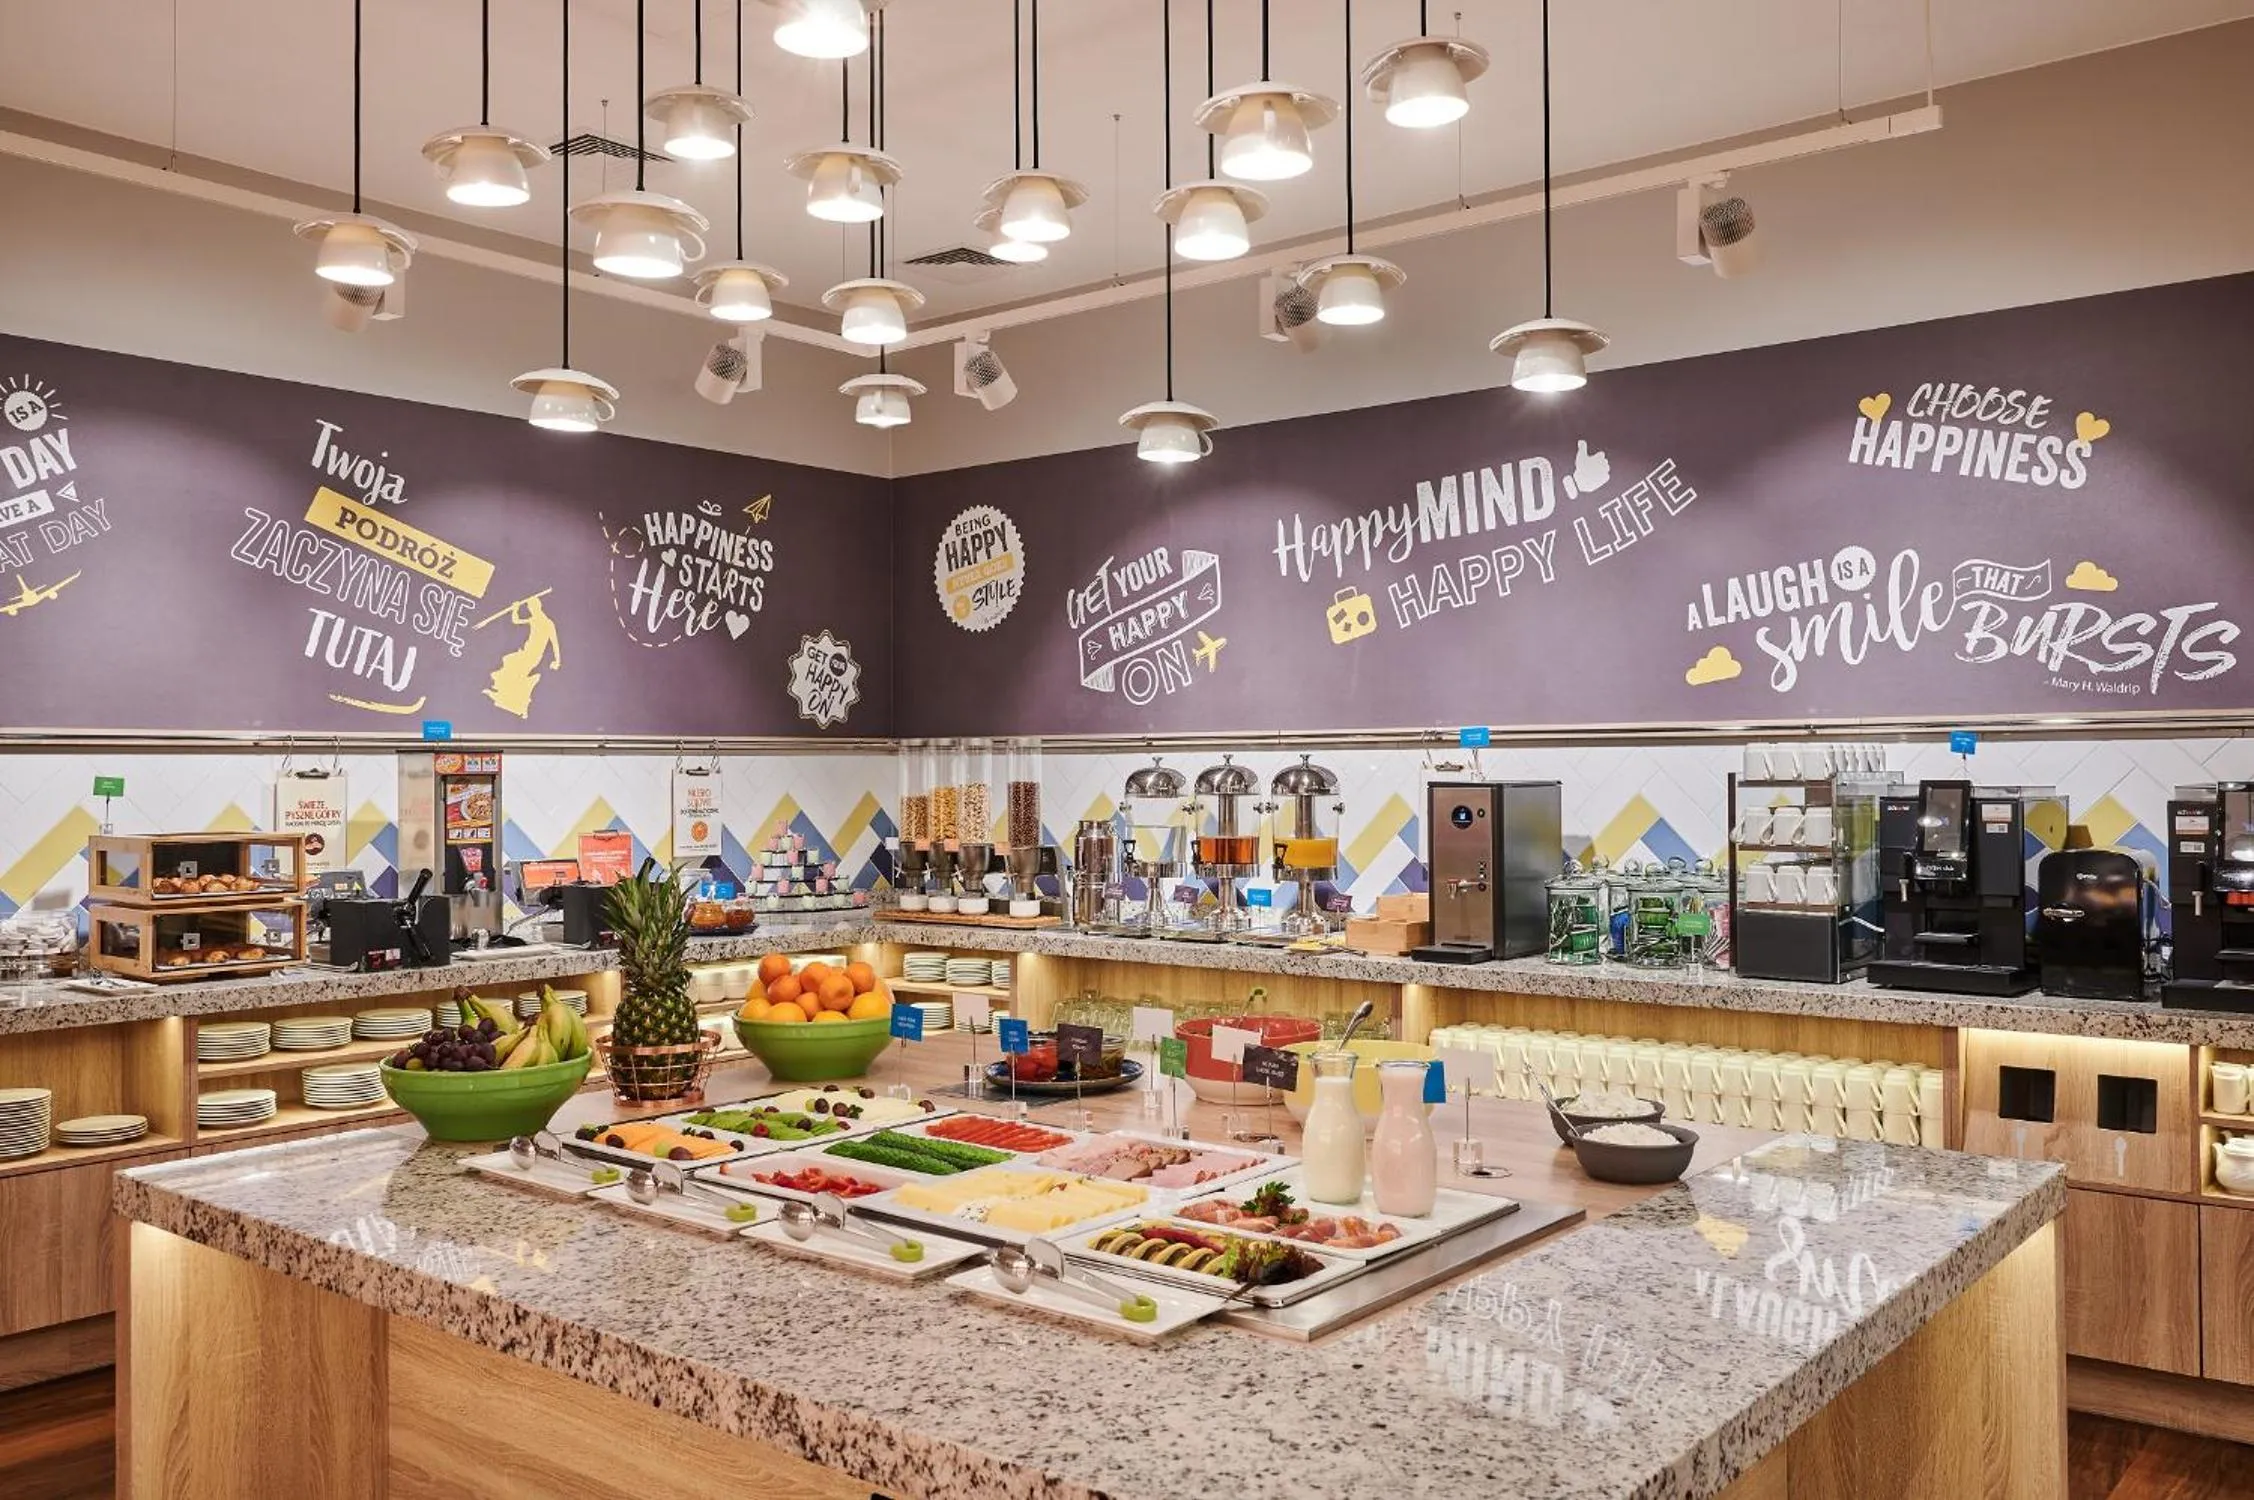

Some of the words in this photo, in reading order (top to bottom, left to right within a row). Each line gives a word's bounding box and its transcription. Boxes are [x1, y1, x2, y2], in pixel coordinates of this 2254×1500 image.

[9, 406, 29, 424] IS
[28, 400, 44, 415] A
[1906, 382, 2053, 429] CHOOSE
[1, 428, 77, 490] DAY
[312, 419, 407, 505] Twoja
[1848, 417, 2092, 489] HAPPINESS
[27, 499, 41, 513] A
[39, 498, 113, 554] DAY
[955, 514, 991, 537] BEING
[1274, 502, 1419, 583] Happy
[1416, 456, 1555, 544] MIND
[335, 505, 458, 579] PODRÓŻ
[644, 512, 774, 572] HAPPINESS
[945, 521, 1008, 572] HAPPY
[1388, 530, 1556, 629] HAPPY
[1574, 458, 1698, 566] LIFE
[231, 507, 410, 624] ZACZYNA
[413, 583, 476, 658] SIĘ
[629, 558, 722, 637] Here
[679, 554, 764, 612] STARTS
[972, 578, 1015, 611] STYLE
[1067, 556, 1114, 629] GET
[1112, 547, 1173, 597] YOUR
[1688, 602, 1703, 631] A
[1702, 559, 1829, 627] LAUGH
[1837, 560, 1854, 580] IS
[1858, 557, 1870, 577] A
[1971, 566, 2024, 596] THAT
[305, 607, 417, 691] TUTAJ
[1108, 590, 1188, 651] HAPPY
[1756, 549, 1956, 692] smile
[806, 662, 849, 704] HAPPY
[807, 646, 828, 665] GET
[1122, 640, 1192, 706] ON
[808, 689, 834, 718] ON
[2051, 677, 2080, 693] Mary
[2096, 681, 2141, 696] Waldrip
